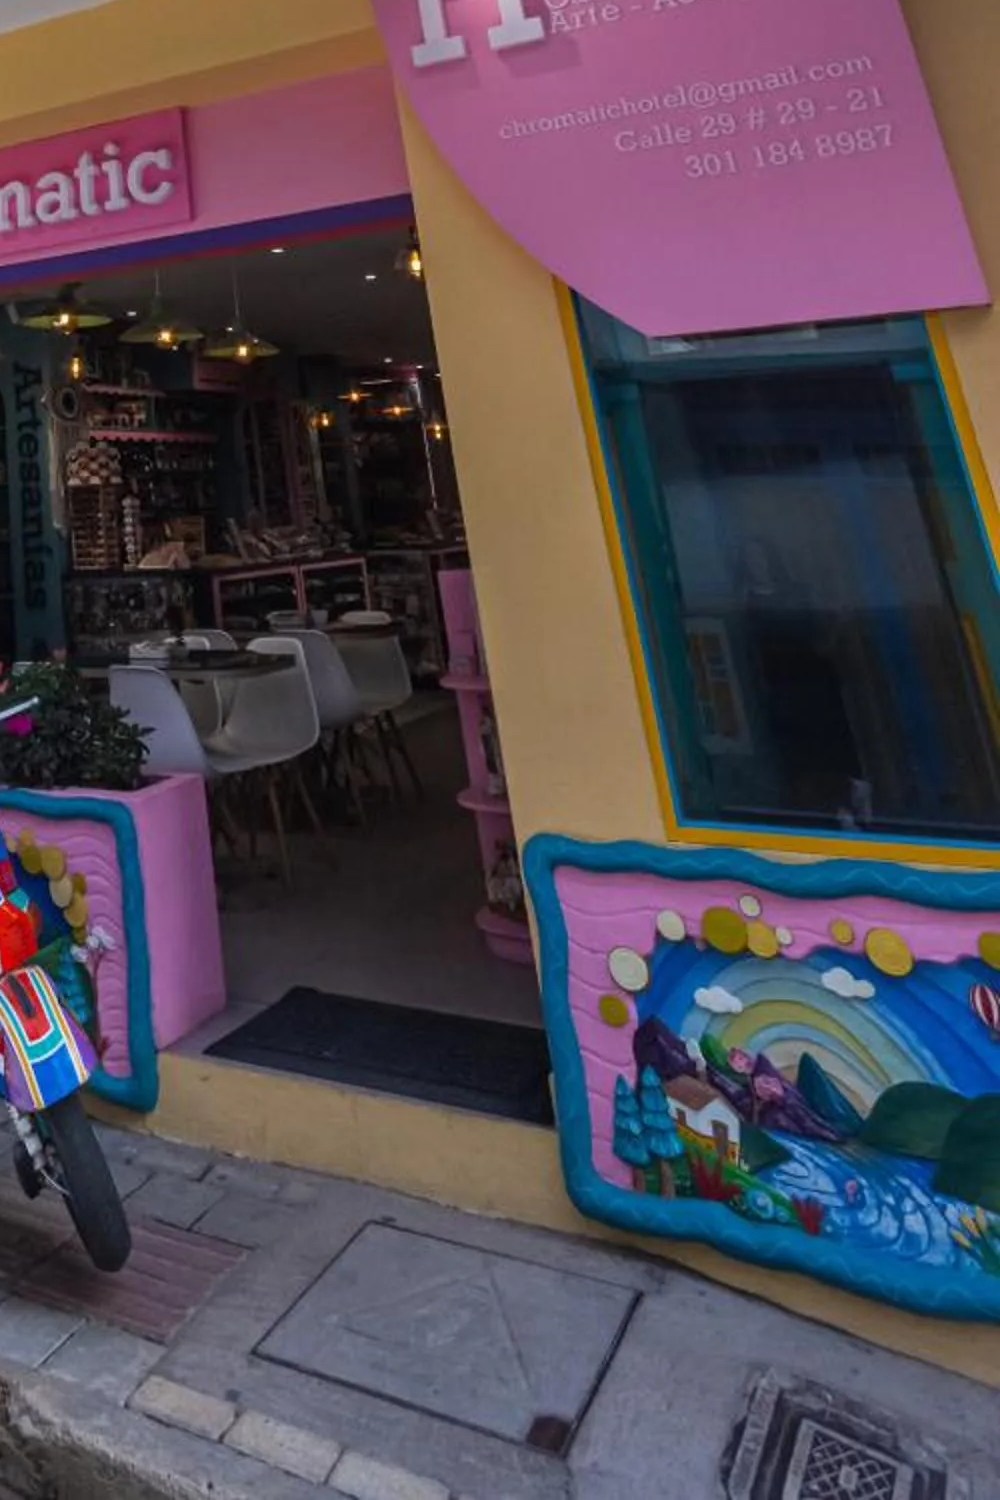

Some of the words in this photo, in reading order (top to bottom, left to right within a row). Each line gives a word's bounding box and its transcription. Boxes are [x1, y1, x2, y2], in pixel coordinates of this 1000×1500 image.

[614, 122, 692, 152] Calle
[702, 113, 736, 138] 29
[747, 107, 765, 130] #
[777, 97, 816, 125] 29
[846, 86, 883, 113] 21
[685, 150, 737, 178] 301
[754, 140, 805, 169] 184
[815, 124, 894, 159] 8987
